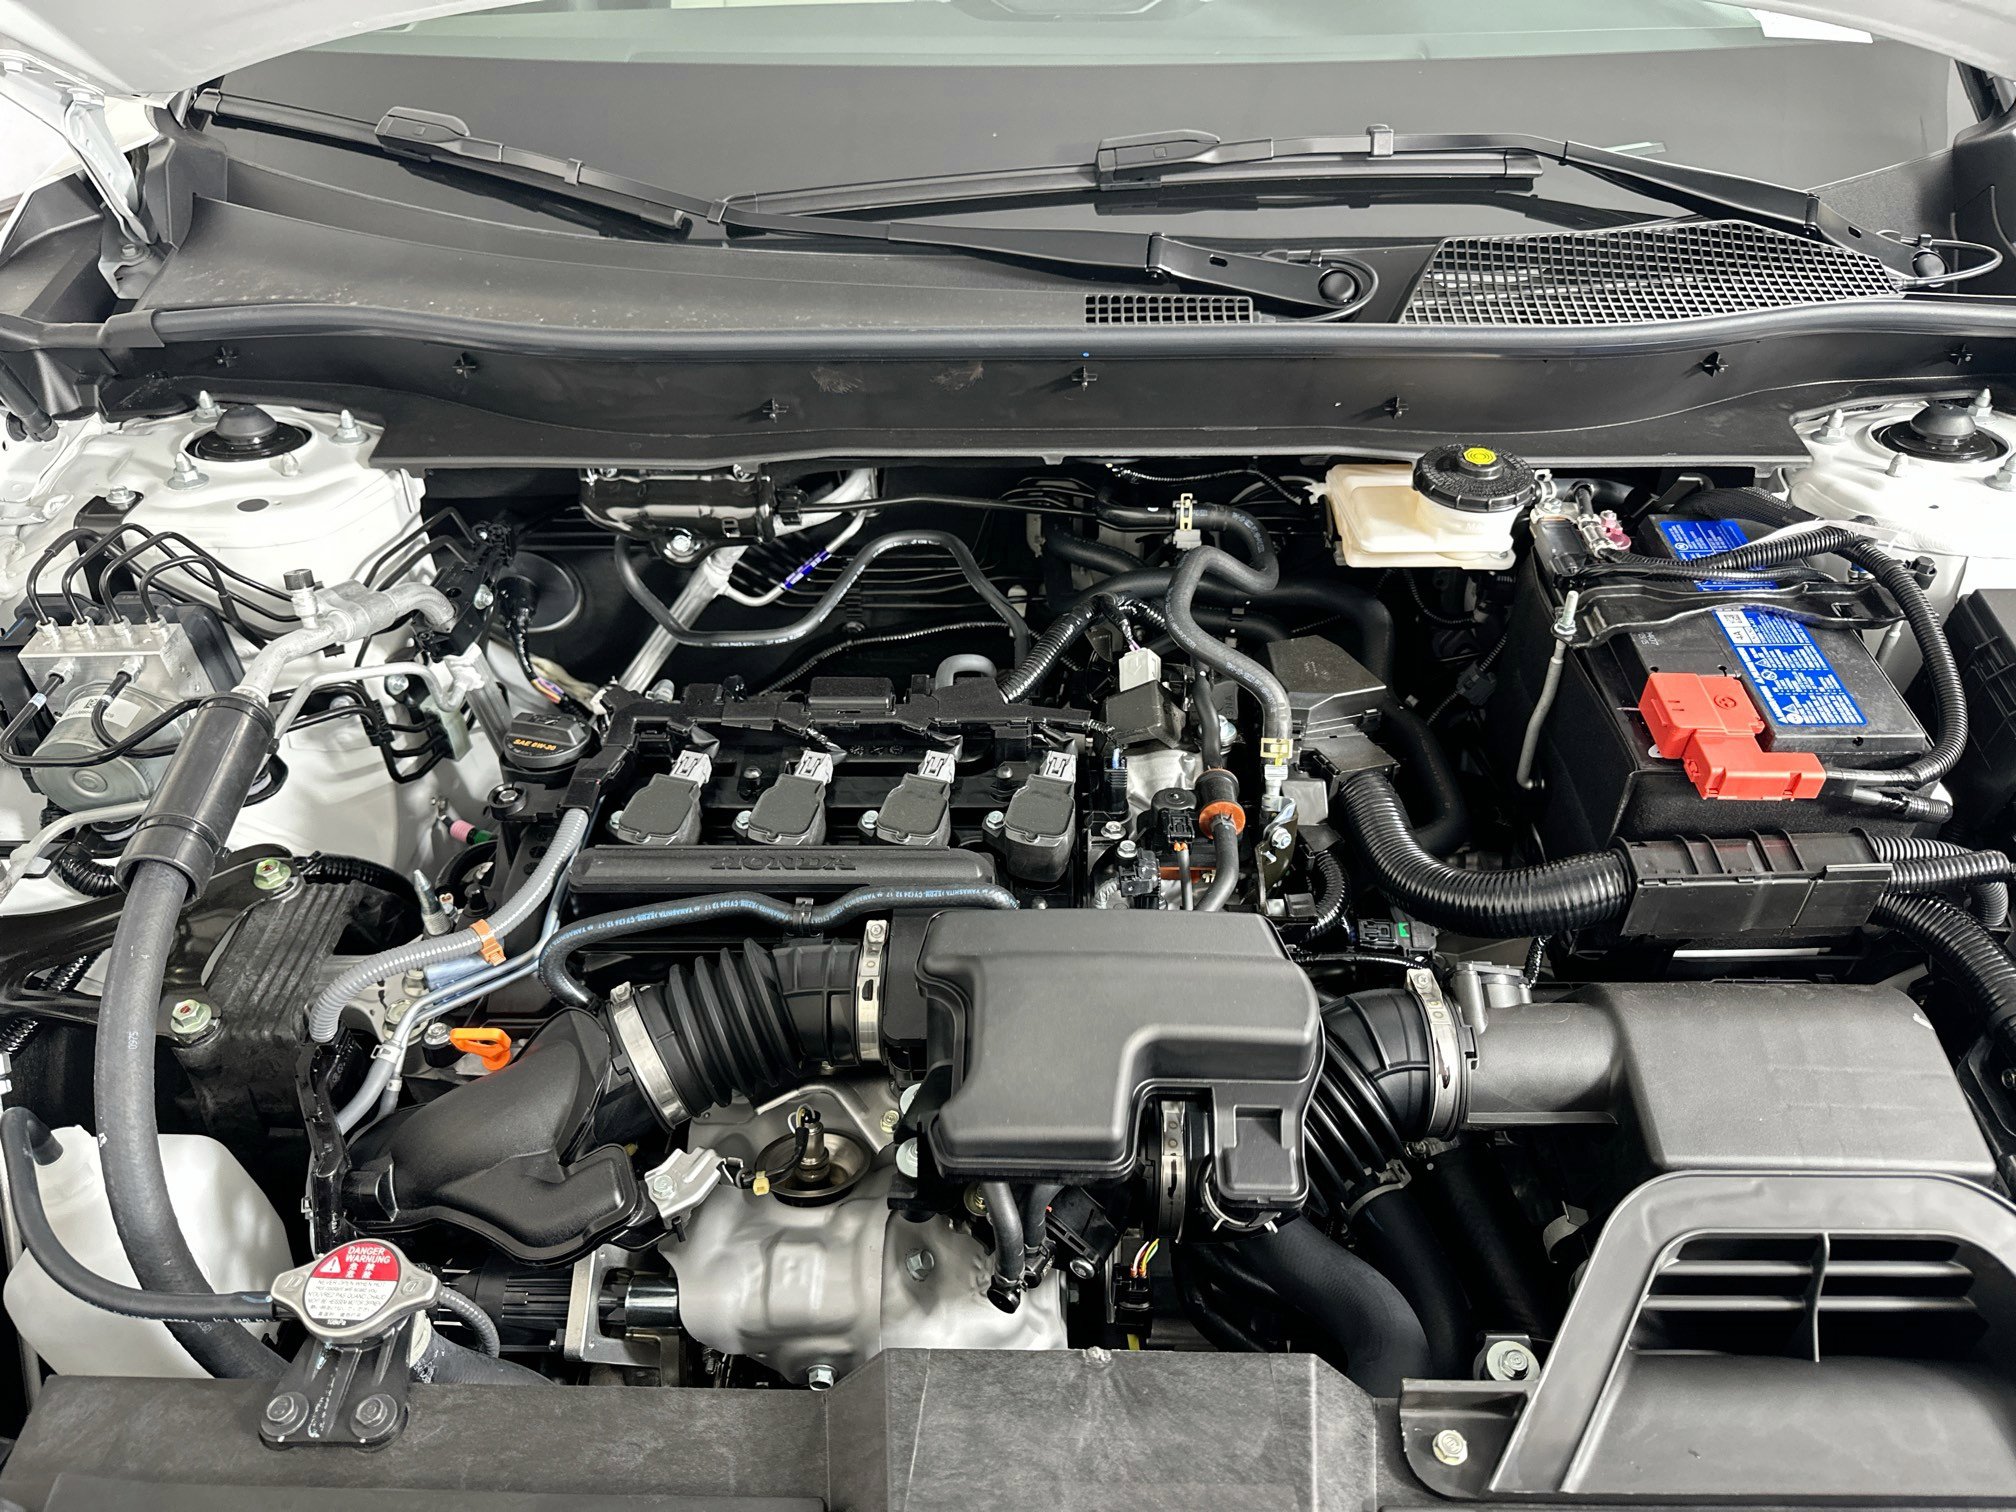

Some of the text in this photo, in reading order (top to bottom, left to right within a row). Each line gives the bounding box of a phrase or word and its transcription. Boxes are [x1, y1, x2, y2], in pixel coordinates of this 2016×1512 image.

[513, 738, 532, 747] SAE
[710, 855, 857, 870] HONDA
[946, 888, 980, 897] YAMASHITA
[347, 1246, 385, 1255] DANGER
[345, 1254, 391, 1264] WARNUNG
